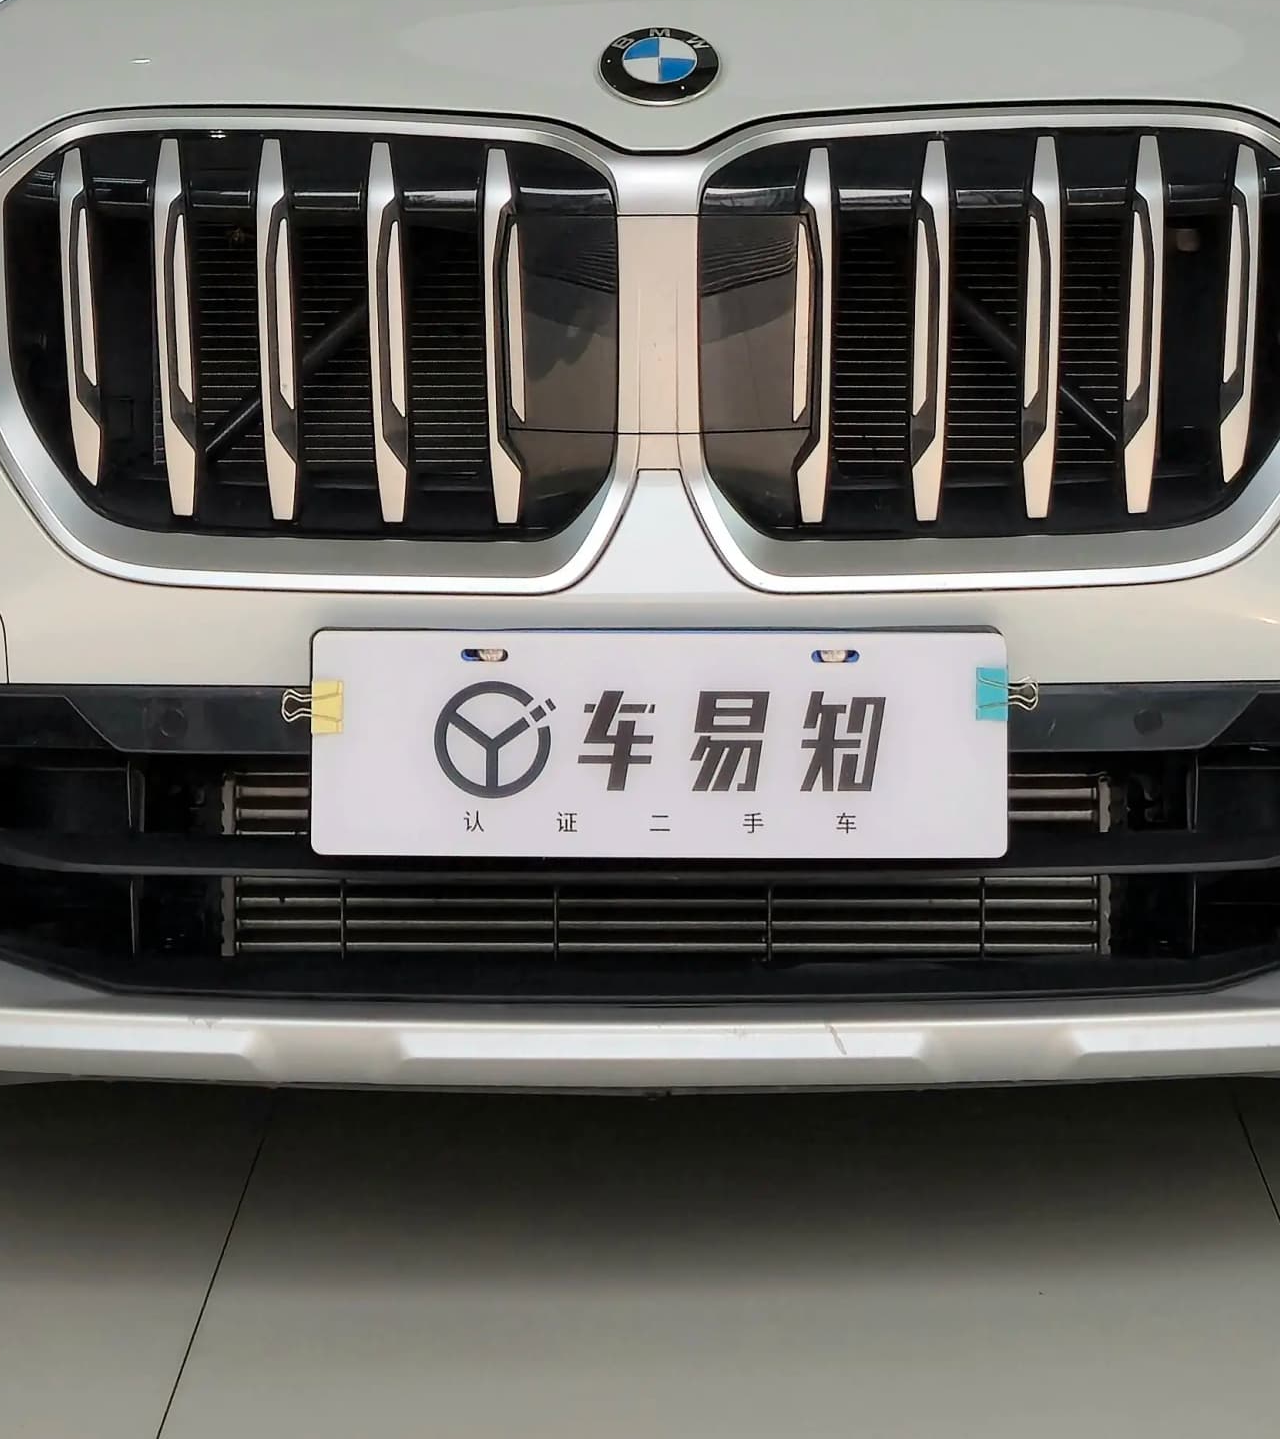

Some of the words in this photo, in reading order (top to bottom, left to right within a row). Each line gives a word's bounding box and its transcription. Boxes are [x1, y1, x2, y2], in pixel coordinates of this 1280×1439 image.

[610, 27, 711, 50] BMW
[577, 690, 887, 793] 车易知
[463, 810, 858, 835] 认证二手车
